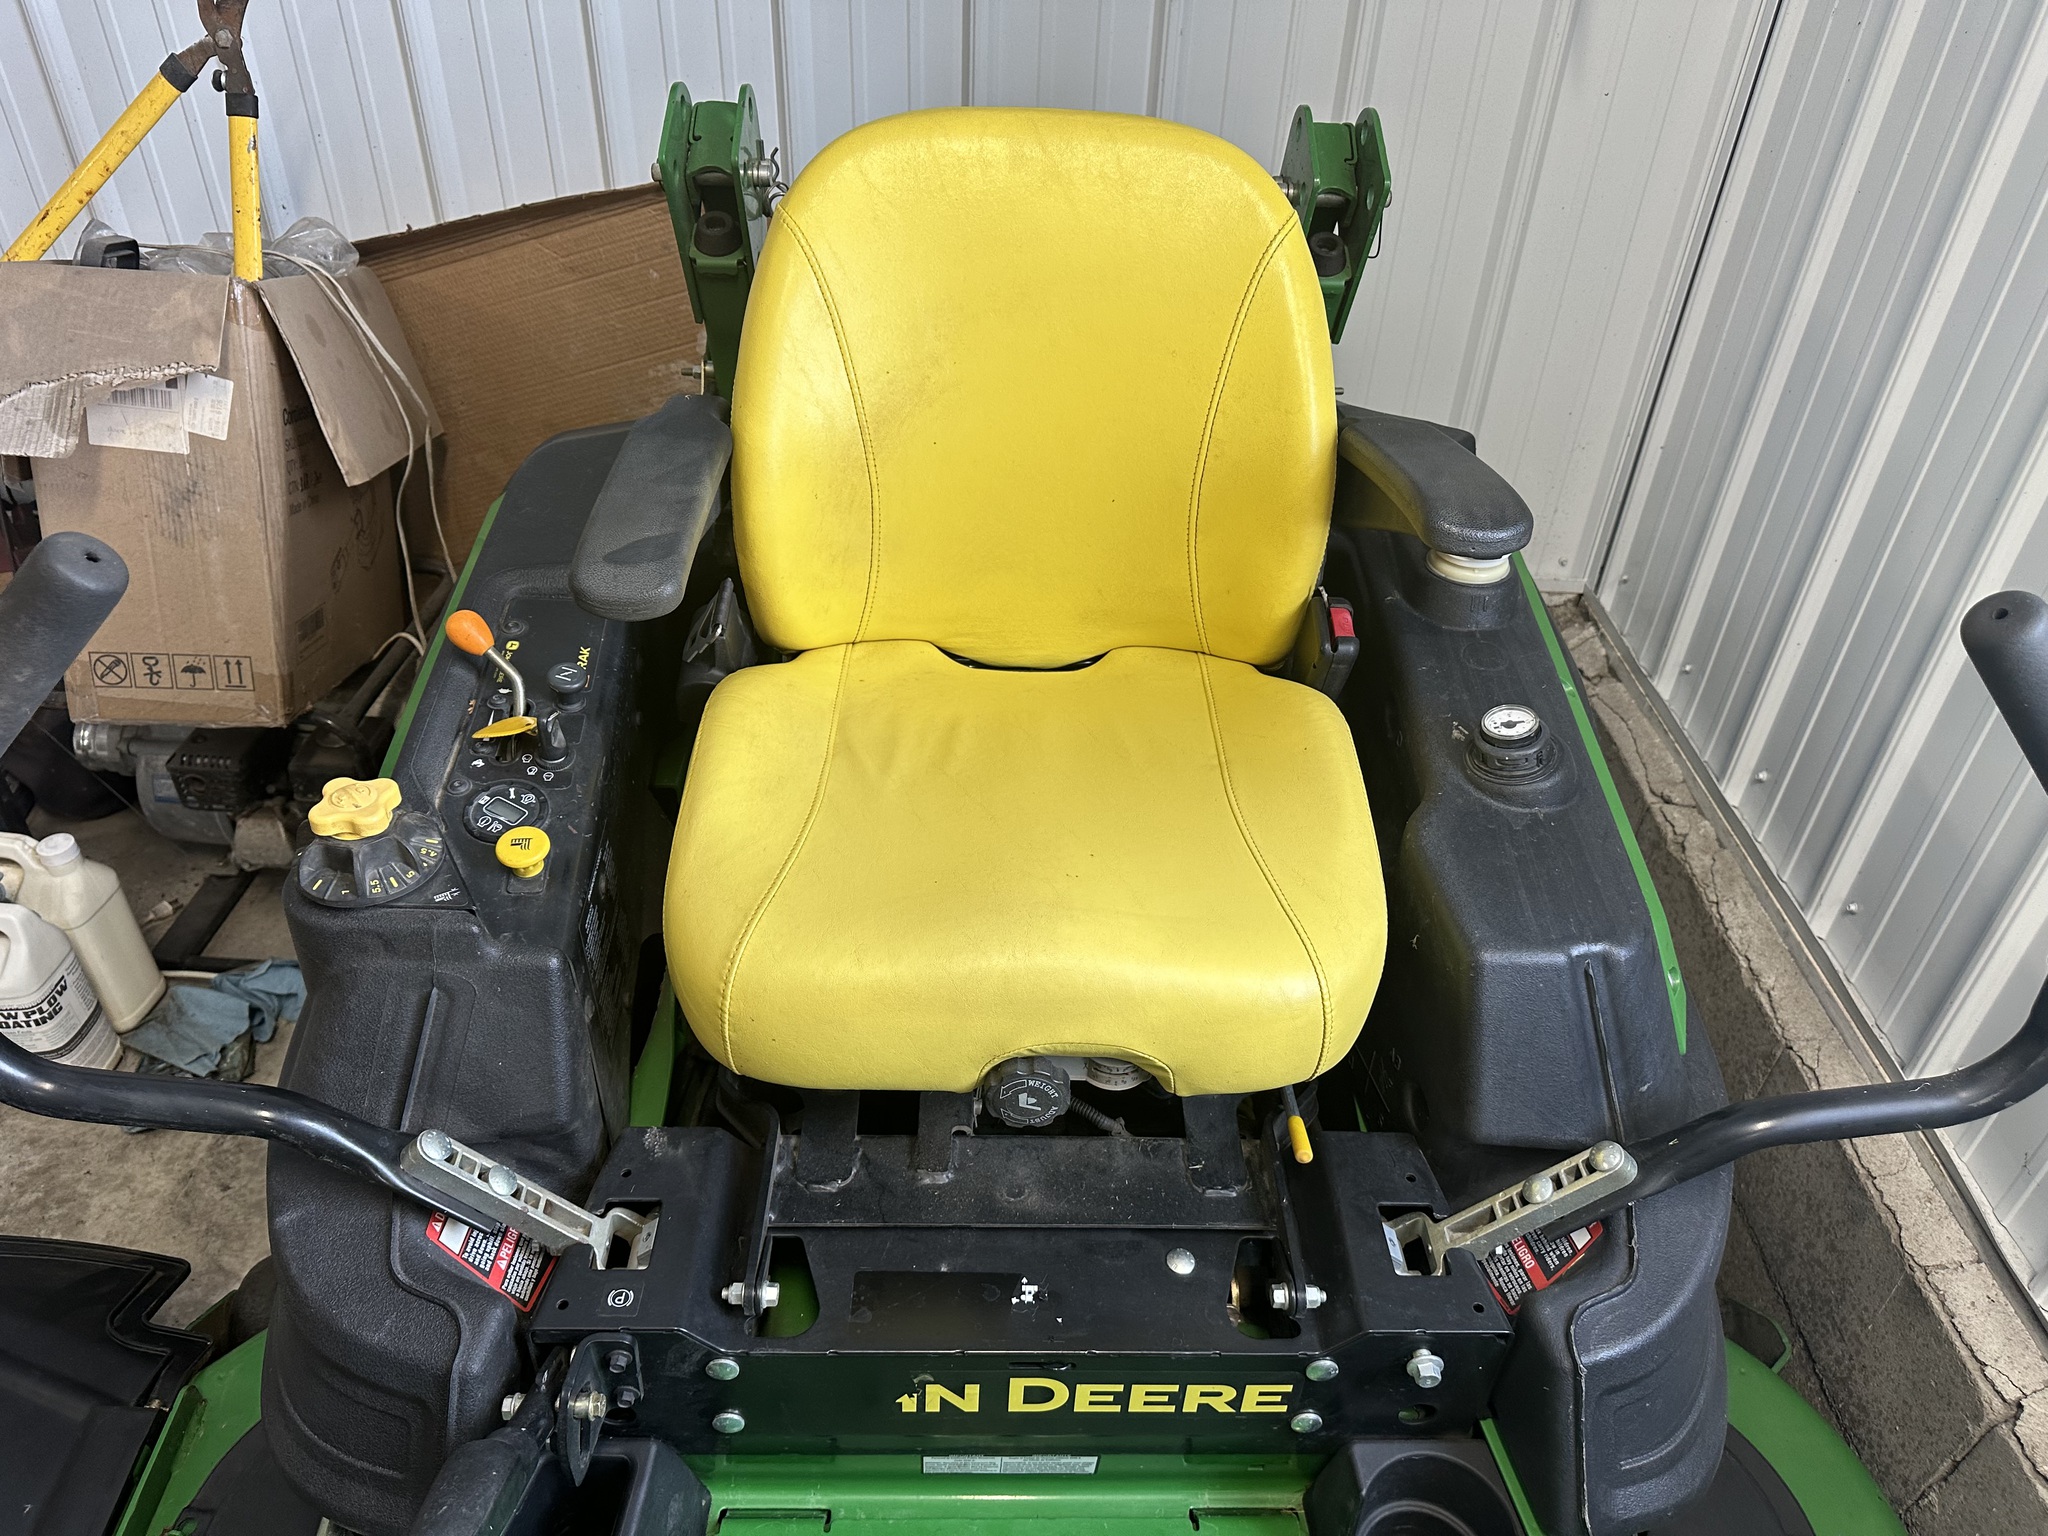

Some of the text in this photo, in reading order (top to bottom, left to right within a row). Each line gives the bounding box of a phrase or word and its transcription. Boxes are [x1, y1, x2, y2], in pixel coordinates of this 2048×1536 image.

[370, 879, 381, 893] 5.5
[22, 979, 68, 1019] PLOW
[1028, 1079, 1059, 1099] WEIGHT
[1029, 1105, 1059, 1124] ADJUST
[464, 1236, 475, 1252] avoid
[484, 1260, 492, 1271] and
[488, 1246, 497, 1260] back
[493, 1231, 503, 1246] down
[462, 1251, 469, 1259] To
[467, 1247, 477, 1262] drive
[473, 1254, 481, 1265] and
[478, 1252, 489, 1268] going
[1548, 1250, 1559, 1265] when
[1008, 1377, 1294, 1412] DEERE
